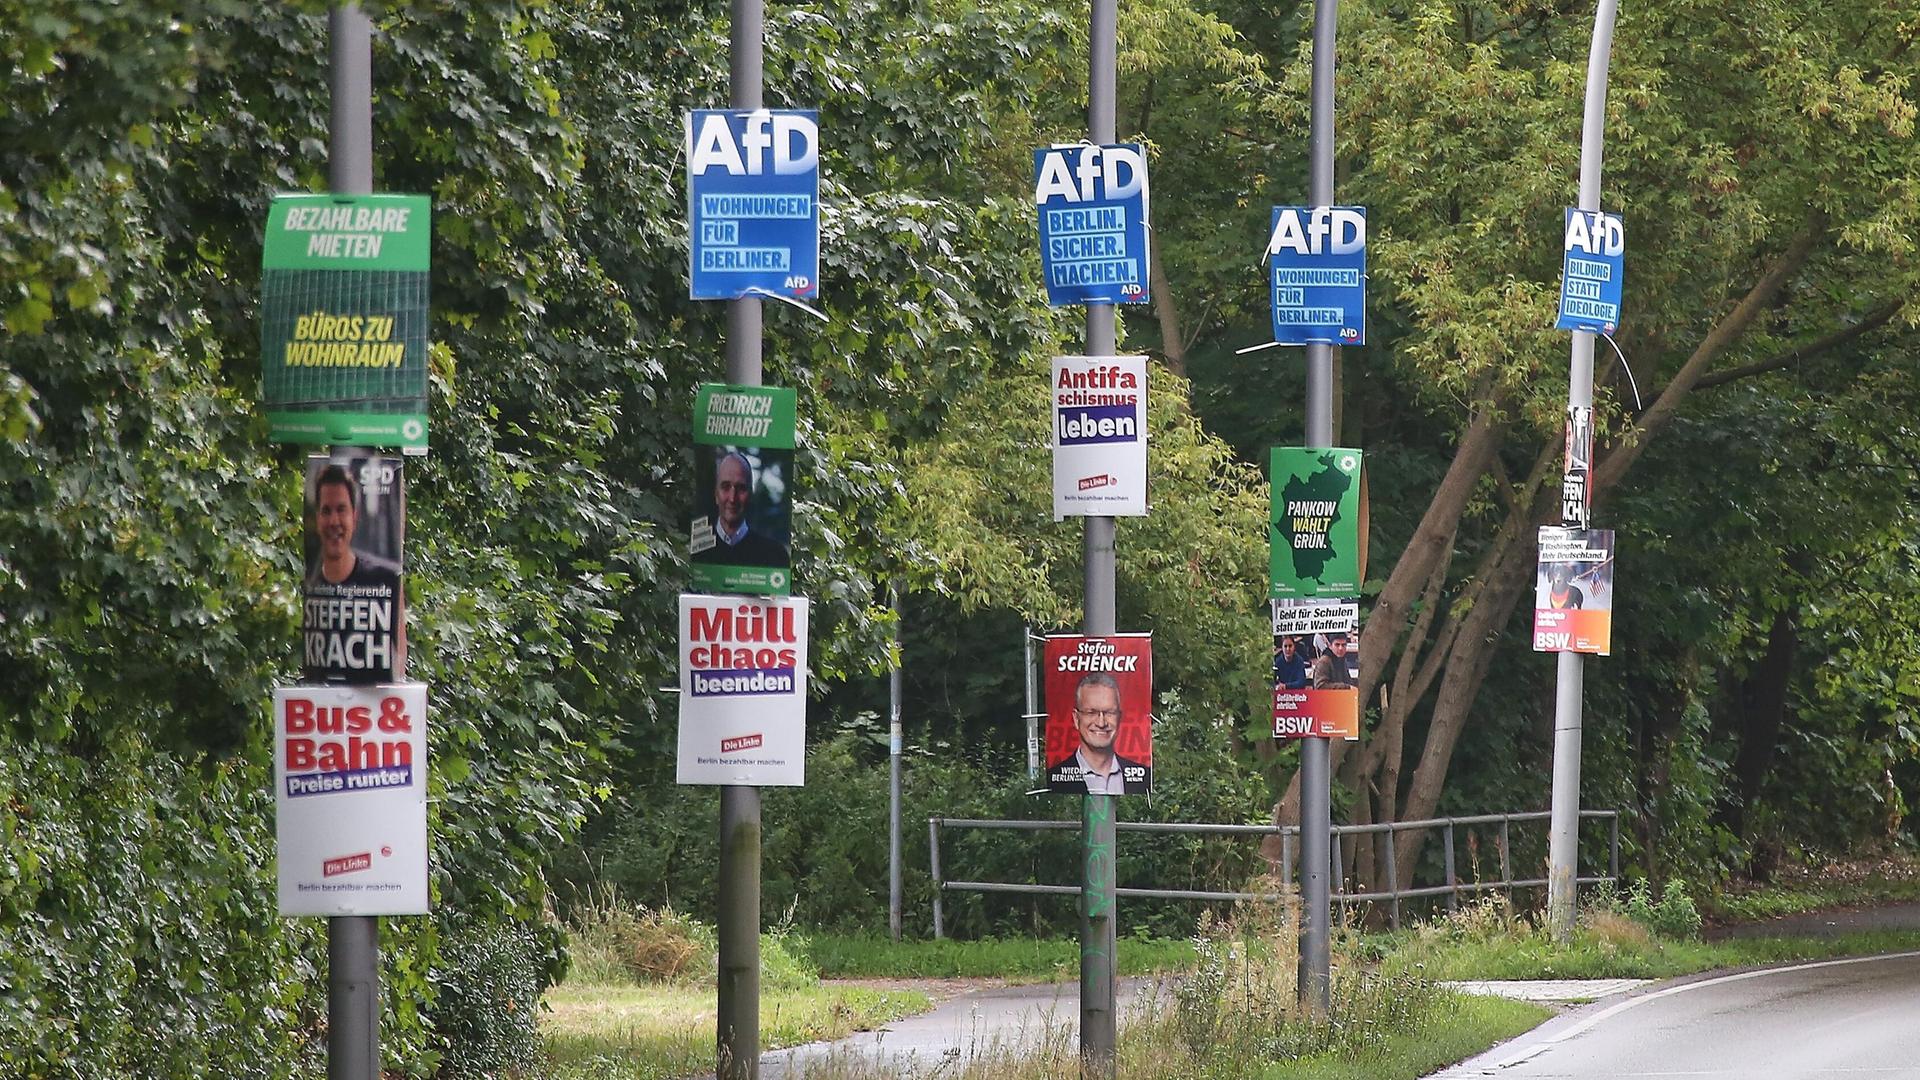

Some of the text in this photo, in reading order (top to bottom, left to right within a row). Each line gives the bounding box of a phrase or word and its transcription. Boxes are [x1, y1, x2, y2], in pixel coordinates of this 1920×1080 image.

[693, 111, 818, 175] AfD
[1036, 147, 1142, 204] AfD
[704, 197, 809, 216] WOHNUNGEN
[284, 207, 411, 232] BEZAHLBARE
[1050, 209, 1123, 233] BERLIN.
[704, 220, 735, 242] FÜR
[1271, 206, 1365, 254] AfD
[1565, 211, 1624, 257] AfD
[307, 233, 383, 258] MIETEN
[1051, 236, 1124, 259] SICHER.
[704, 251, 787, 268] BERLINER.
[1053, 262, 1136, 286] MACHEN.
[1278, 270, 1357, 285] WOHNUNGEN
[1569, 261, 1609, 279] BILDUNG
[784, 277, 809, 288] AfD
[1121, 284, 1142, 295] AfD
[1568, 281, 1598, 297] STATT
[1278, 287, 1301, 304] FÜR
[1278, 309, 1342, 324] BERLINER.
[1566, 300, 1615, 320] IDEOLOGIE.
[295, 311, 393, 341] BÜROS ZU
[1340, 328, 1357, 338] AfD
[285, 342, 405, 368] WOHNRAUM
[1058, 366, 1137, 389] Antifa
[707, 393, 773, 415] FRIEDRICH
[1058, 390, 1137, 406] schismus
[705, 415, 773, 438] EHRHARDT
[1060, 413, 1135, 439] leben
[1287, 501, 1336, 517] PANKOW
[1293, 515, 1331, 532] WÄHLT
[1294, 530, 1327, 549] GRÜN.
[336, 585, 392, 599] Regierende
[304, 599, 392, 632] STEFFEN
[1280, 607, 1353, 620] Geld für Schulen
[690, 605, 797, 643] Müll
[1276, 619, 1348, 633] statt für Waffen!
[304, 631, 391, 669] KRACH
[1078, 642, 1115, 656] Stefan
[1536, 632, 1571, 649] BSW
[690, 644, 798, 669] chaos
[1058, 655, 1138, 672] SCHENCK
[694, 672, 791, 693] beenden
[285, 697, 412, 735] Bus &
[1276, 717, 1312, 734] BSW
[286, 736, 412, 771] Bahn
[724, 741, 738, 750] Die
[697, 757, 719, 765] Berlin
[757, 758, 786, 766] machen
[1124, 767, 1145, 777] SPD
[288, 770, 409, 795] Preise runter
[343, 858, 369, 871] Linke
